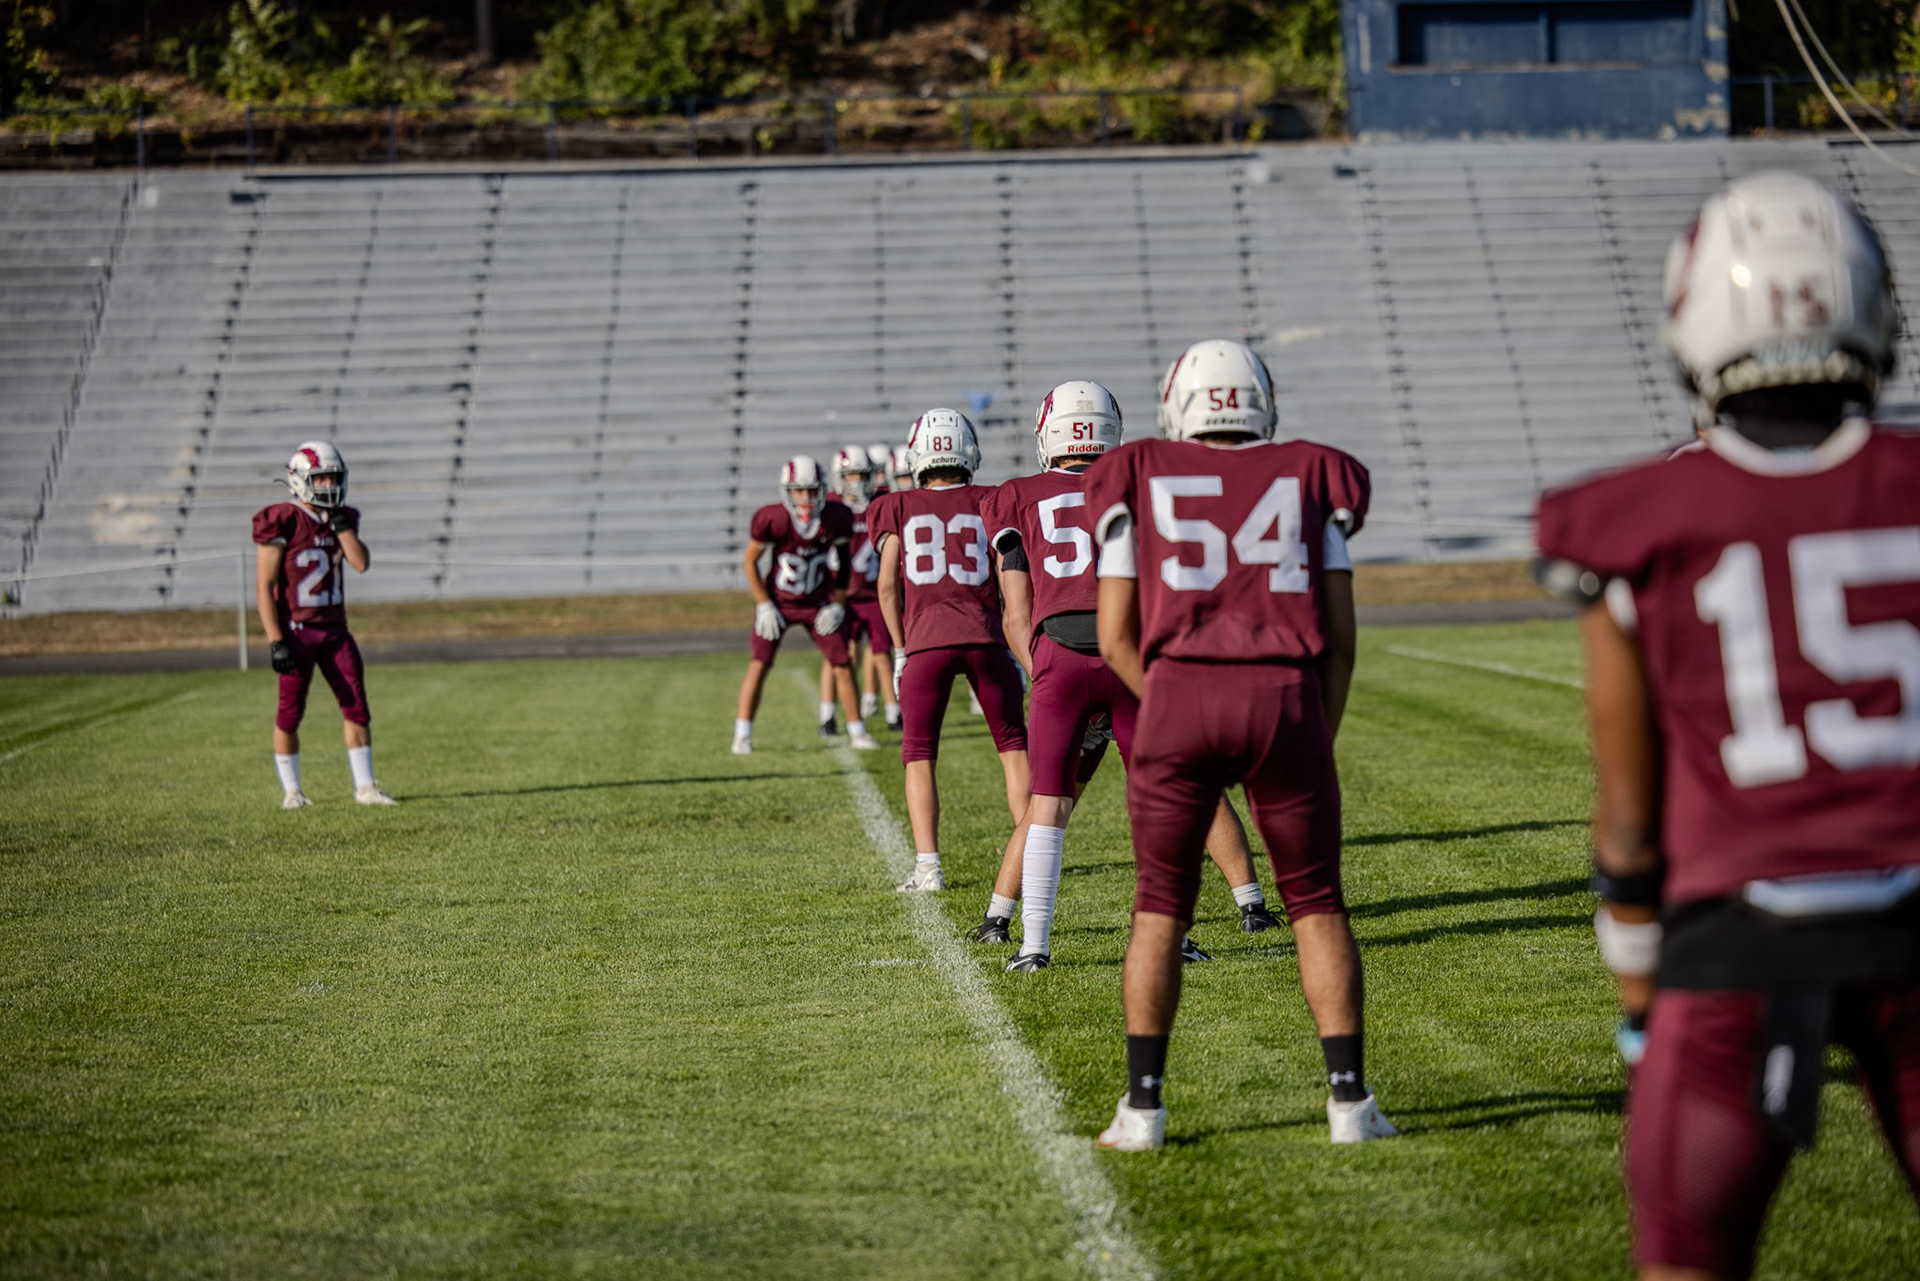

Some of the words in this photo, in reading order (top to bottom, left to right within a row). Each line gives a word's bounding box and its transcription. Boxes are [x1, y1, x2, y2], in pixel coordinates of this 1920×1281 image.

[1208, 387, 1239, 412] 54
[933, 436, 953, 452] 83
[1067, 444, 1105, 453] Riddell
[1072, 422, 1094, 440] 51
[931, 456, 957, 464] schutt
[903, 513, 989, 586] 83
[1038, 492, 1093, 578] 5
[1149, 475, 1309, 593] 54
[296, 548, 342, 608] 21
[1694, 524, 1920, 790] 15
